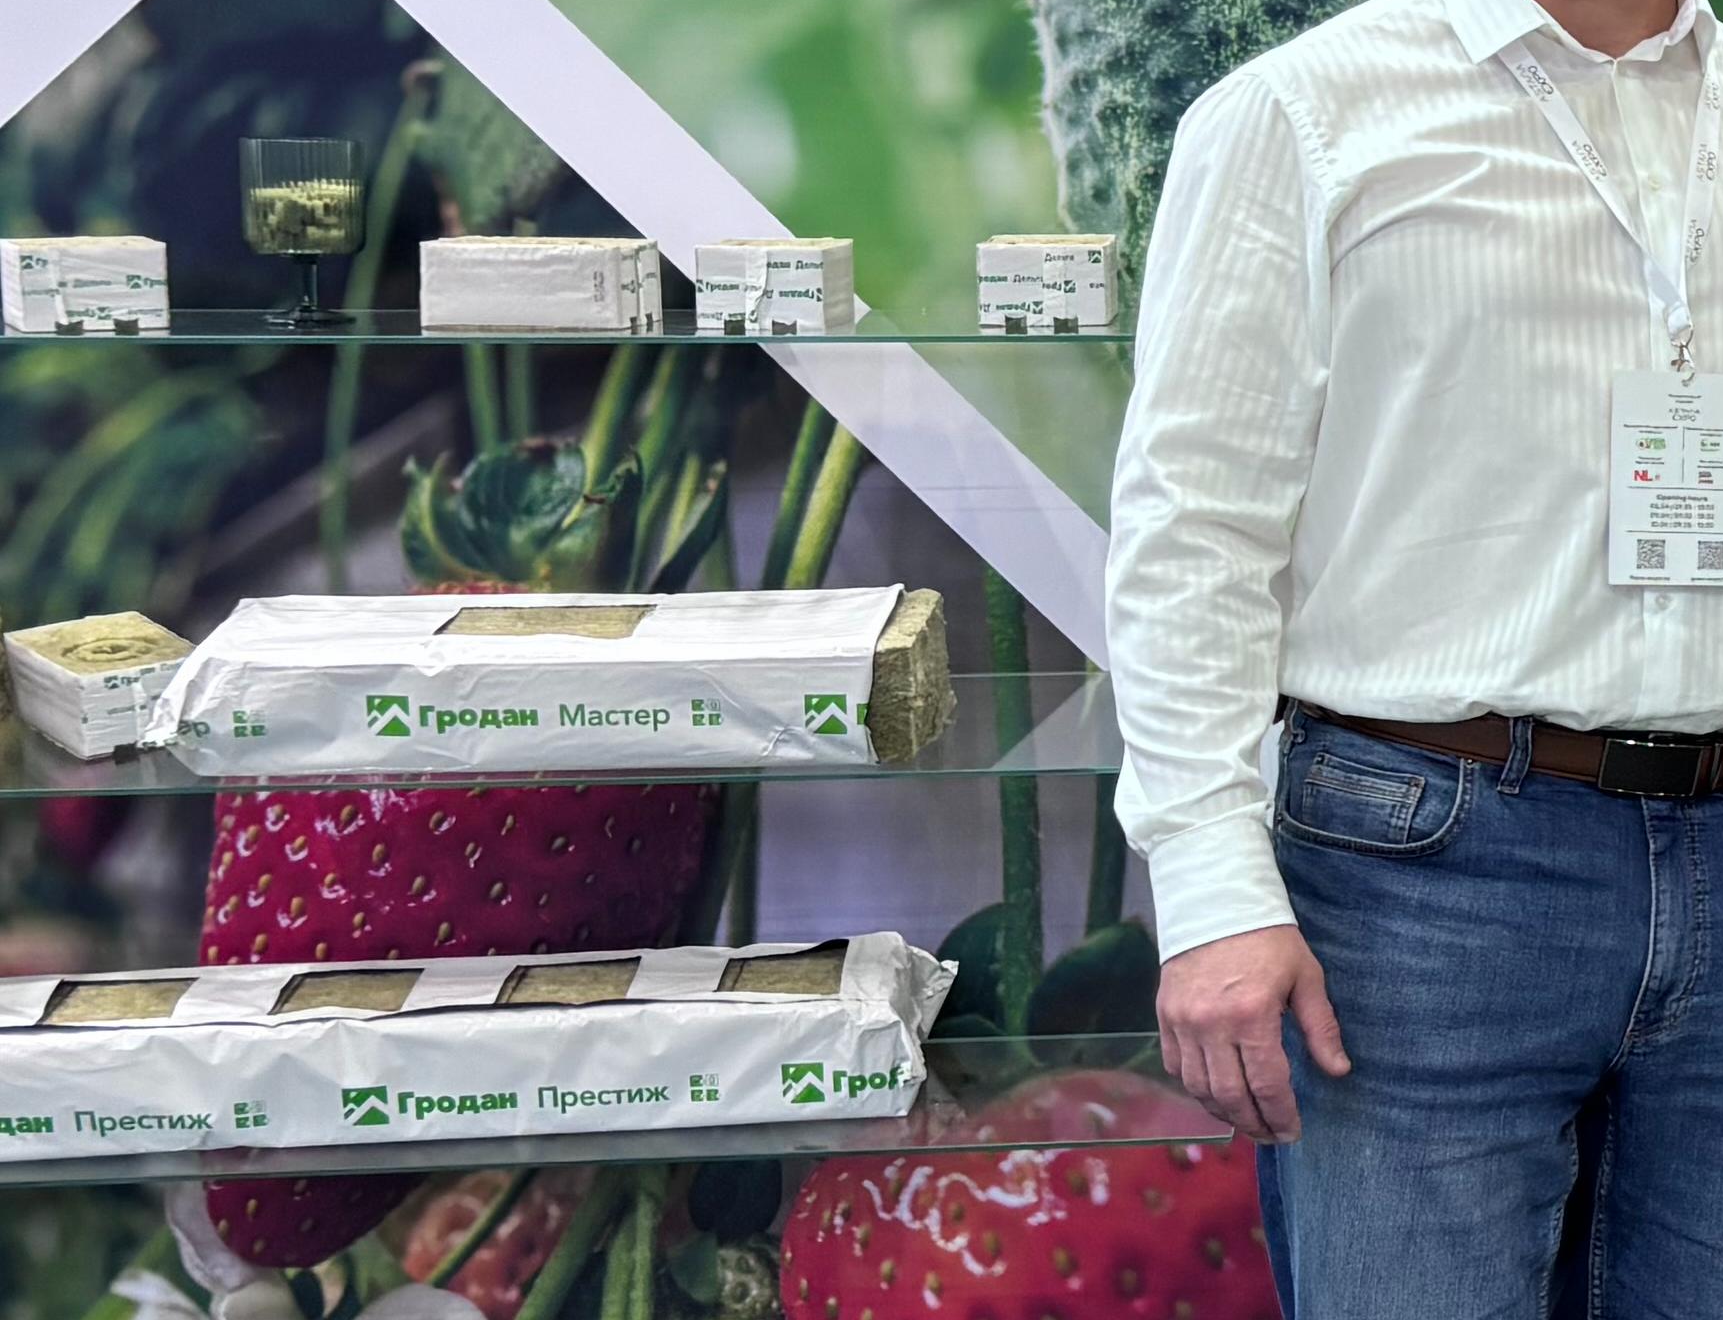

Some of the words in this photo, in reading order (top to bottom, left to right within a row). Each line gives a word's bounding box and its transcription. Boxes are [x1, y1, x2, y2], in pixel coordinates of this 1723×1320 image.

[418, 705, 539, 733] Гродан
[559, 703, 671, 732] Мастер
[397, 1090, 520, 1122] Гродан
[537, 1085, 670, 1114] Престиж
[74, 1110, 213, 1137] Престиж
